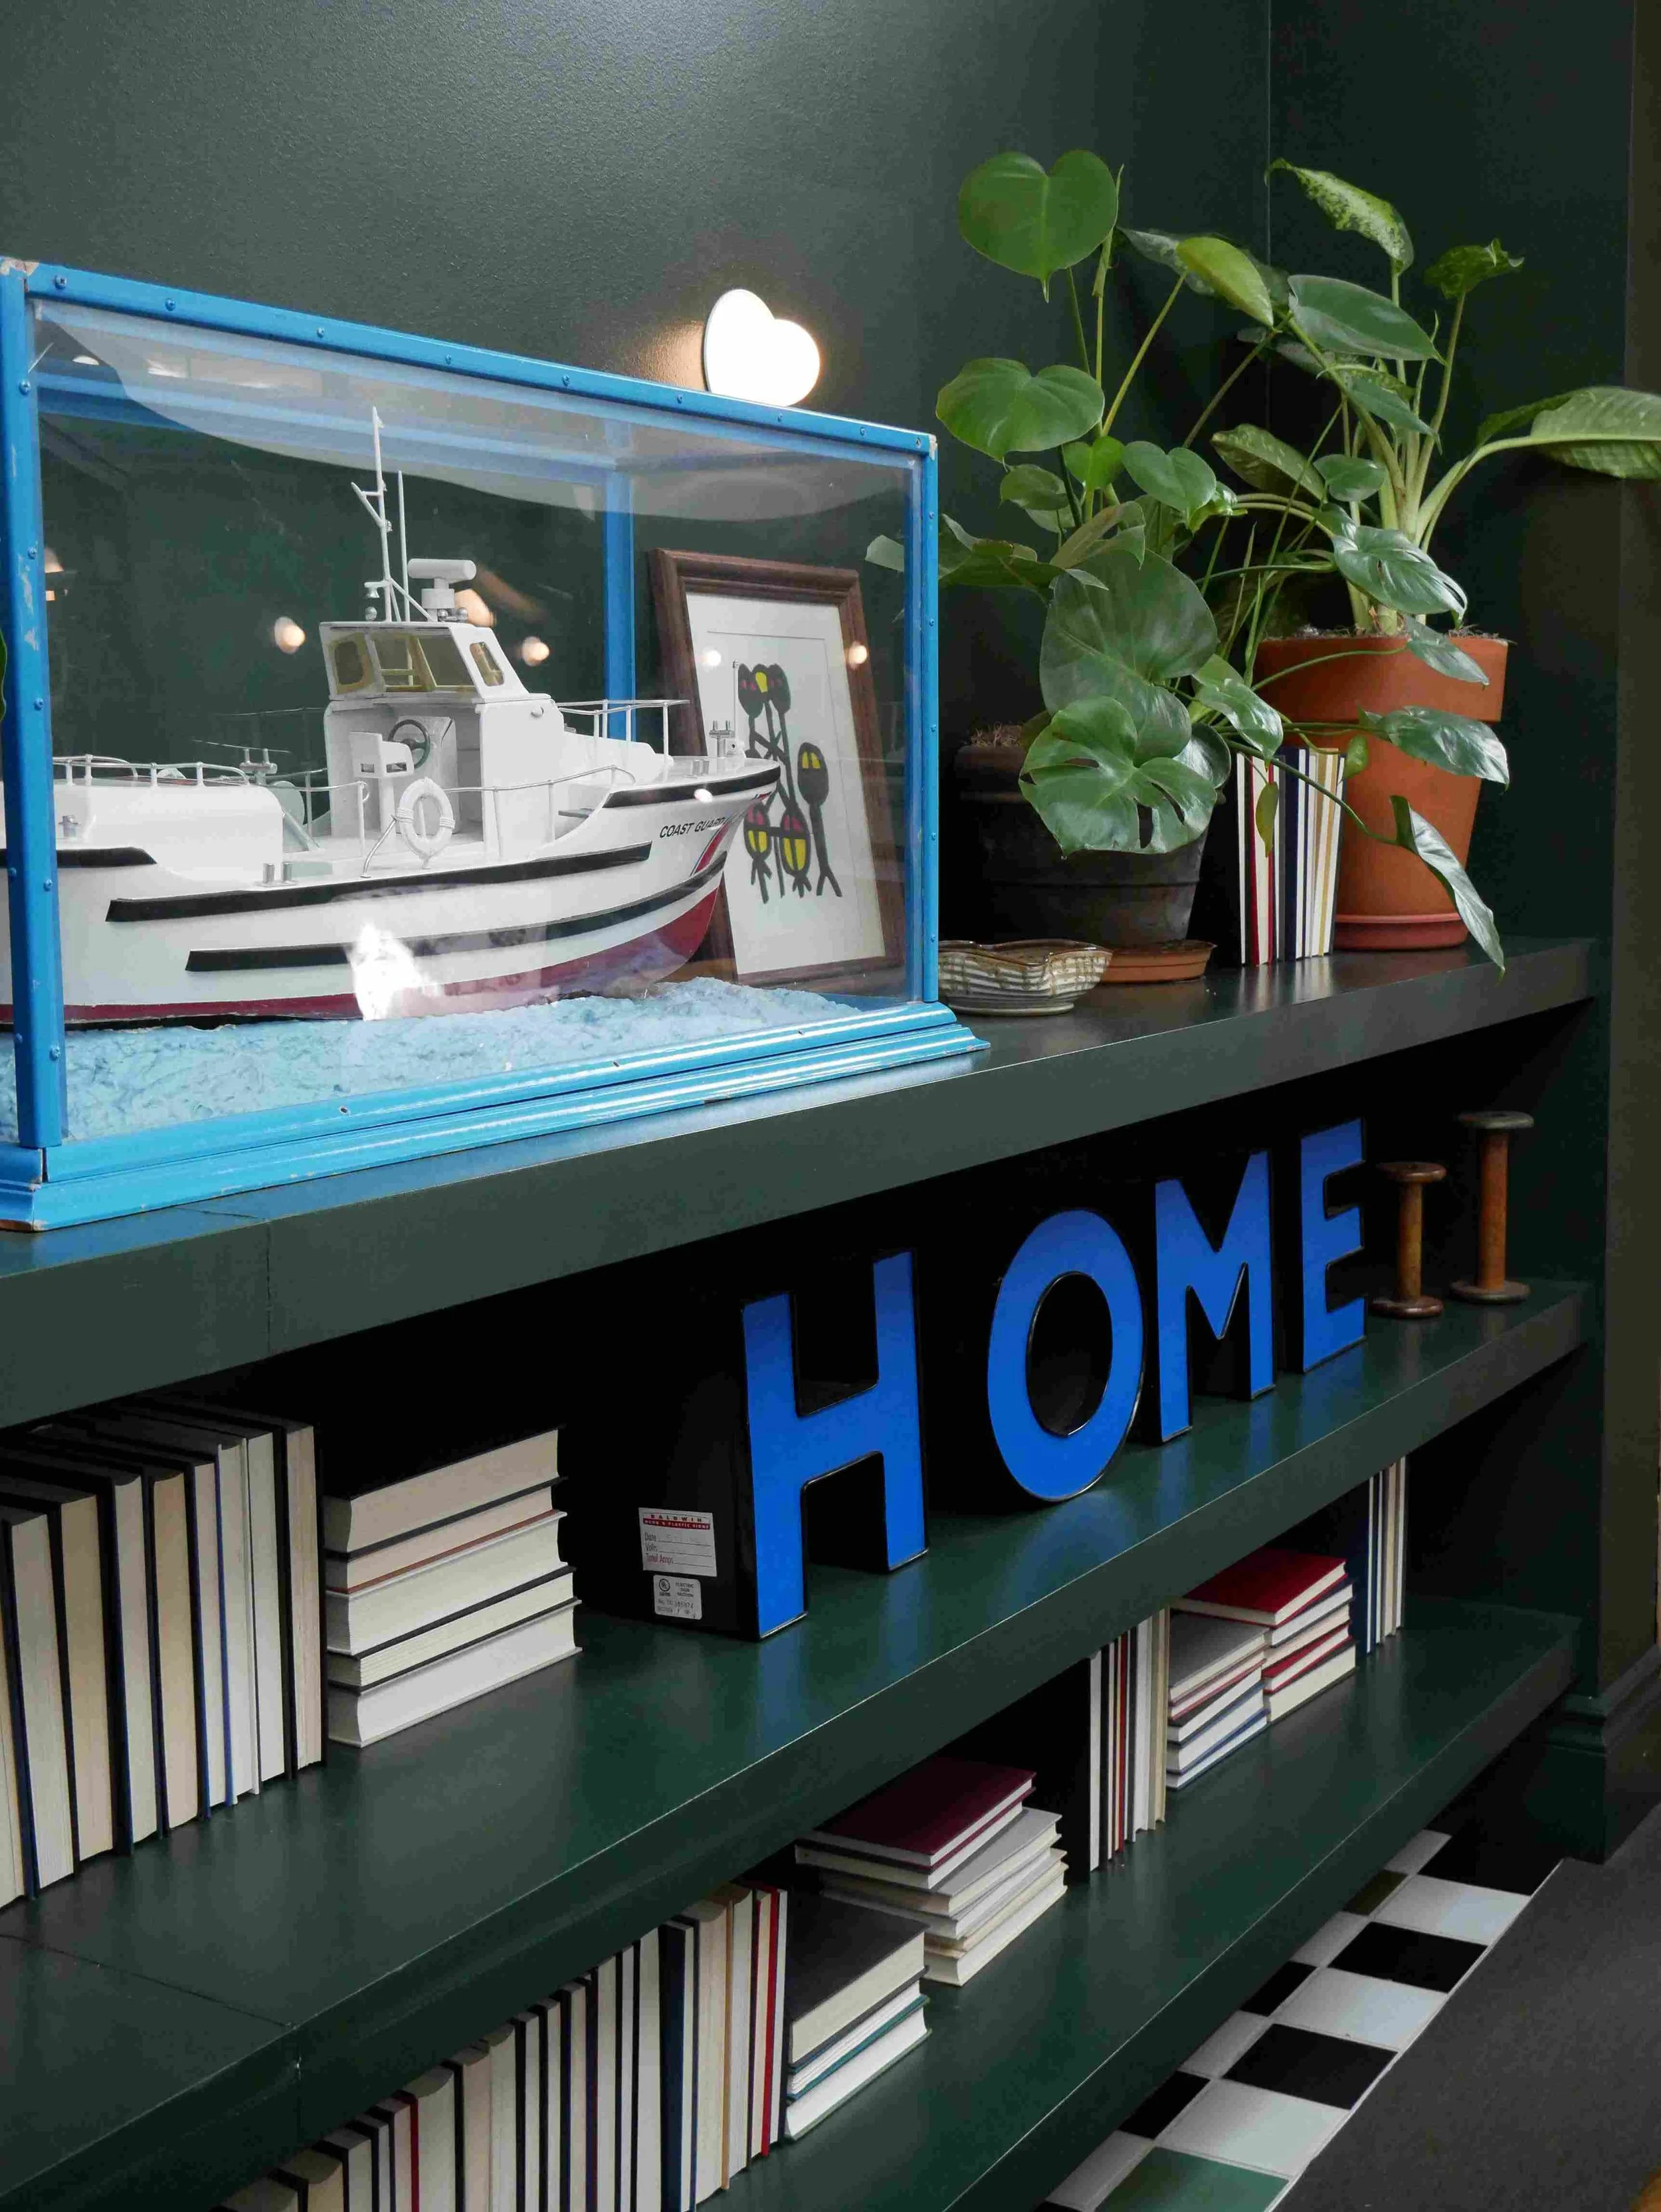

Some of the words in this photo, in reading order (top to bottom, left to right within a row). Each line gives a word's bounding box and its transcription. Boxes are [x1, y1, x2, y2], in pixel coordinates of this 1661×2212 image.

[659, 823, 694, 838] COAST
[694, 817, 726, 832] GUARD
[741, 1118, 1366, 1639] HOME
[644, 1532, 656, 1542] Date
[645, 1542, 657, 1552] Volts
[646, 1552, 658, 1563] Total
[659, 1554, 674, 1565] Amps
